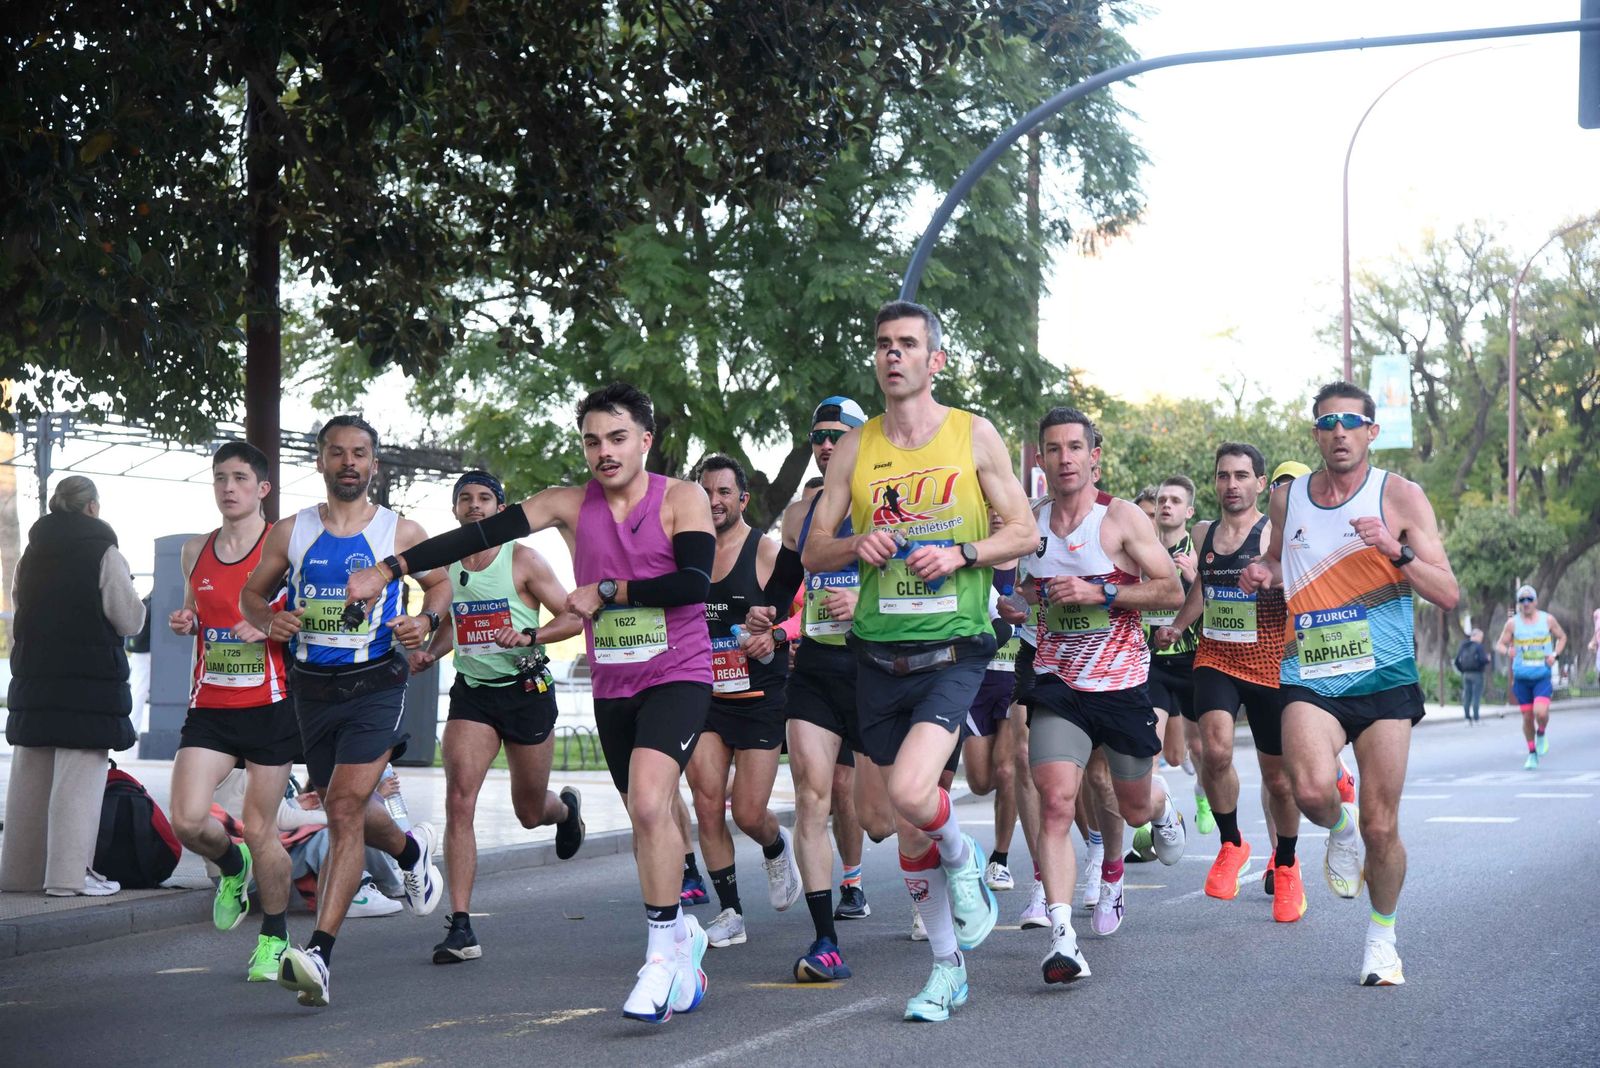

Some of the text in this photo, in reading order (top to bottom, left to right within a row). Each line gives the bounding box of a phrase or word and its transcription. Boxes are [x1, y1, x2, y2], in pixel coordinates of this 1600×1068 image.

[908, 516, 962, 535] Athlétisme
[824, 575, 858, 585] ZURICH
[321, 588, 346, 596] ZURI
[1217, 590, 1249, 599] ZURICH
[322, 606, 342, 615] 1672
[472, 602, 501, 612] ZURICH
[1218, 606, 1234, 615] 1901
[1316, 609, 1358, 623] ZURICH
[474, 620, 490, 628] 1265
[615, 617, 636, 627] 1622
[1058, 616, 1090, 630] YVES
[1212, 617, 1244, 629] ARCOS
[595, 632, 667, 647] PAUL GUIRAUD
[1321, 631, 1342, 642] 1559
[223, 649, 240, 657] 1725
[1304, 640, 1366, 663] RAPHAËL
[206, 663, 264, 673] LIAM COTTER
[718, 667, 749, 680] REGAL
